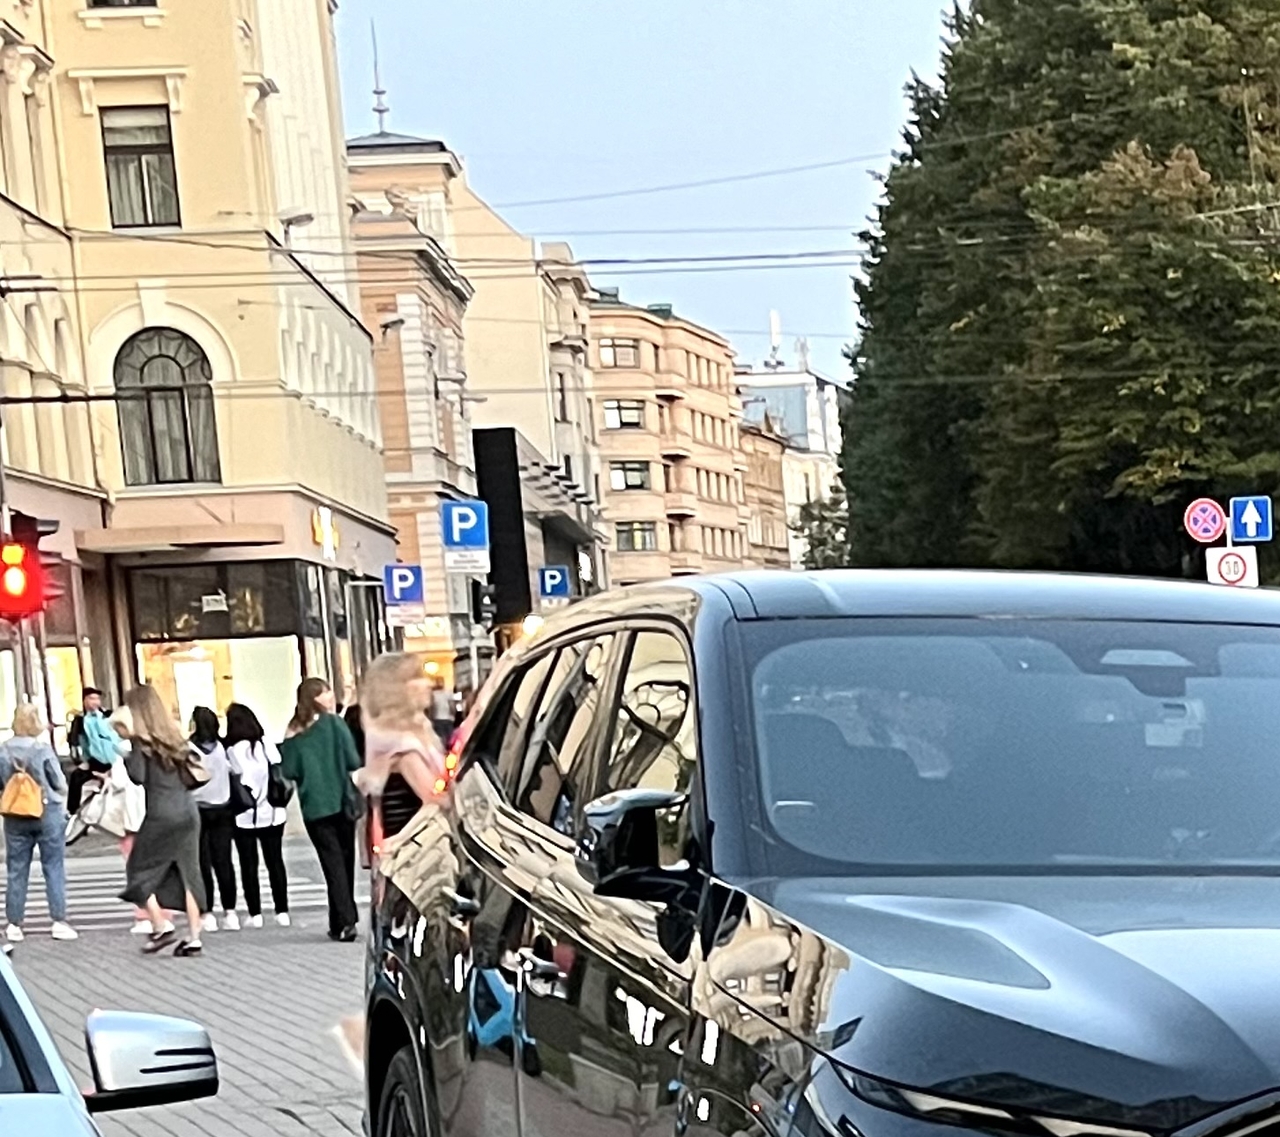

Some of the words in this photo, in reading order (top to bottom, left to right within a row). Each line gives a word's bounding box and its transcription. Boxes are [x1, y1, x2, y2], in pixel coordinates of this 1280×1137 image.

[451, 506, 478, 542] P
[392, 568, 415, 600] P
[544, 570, 562, 593] P
